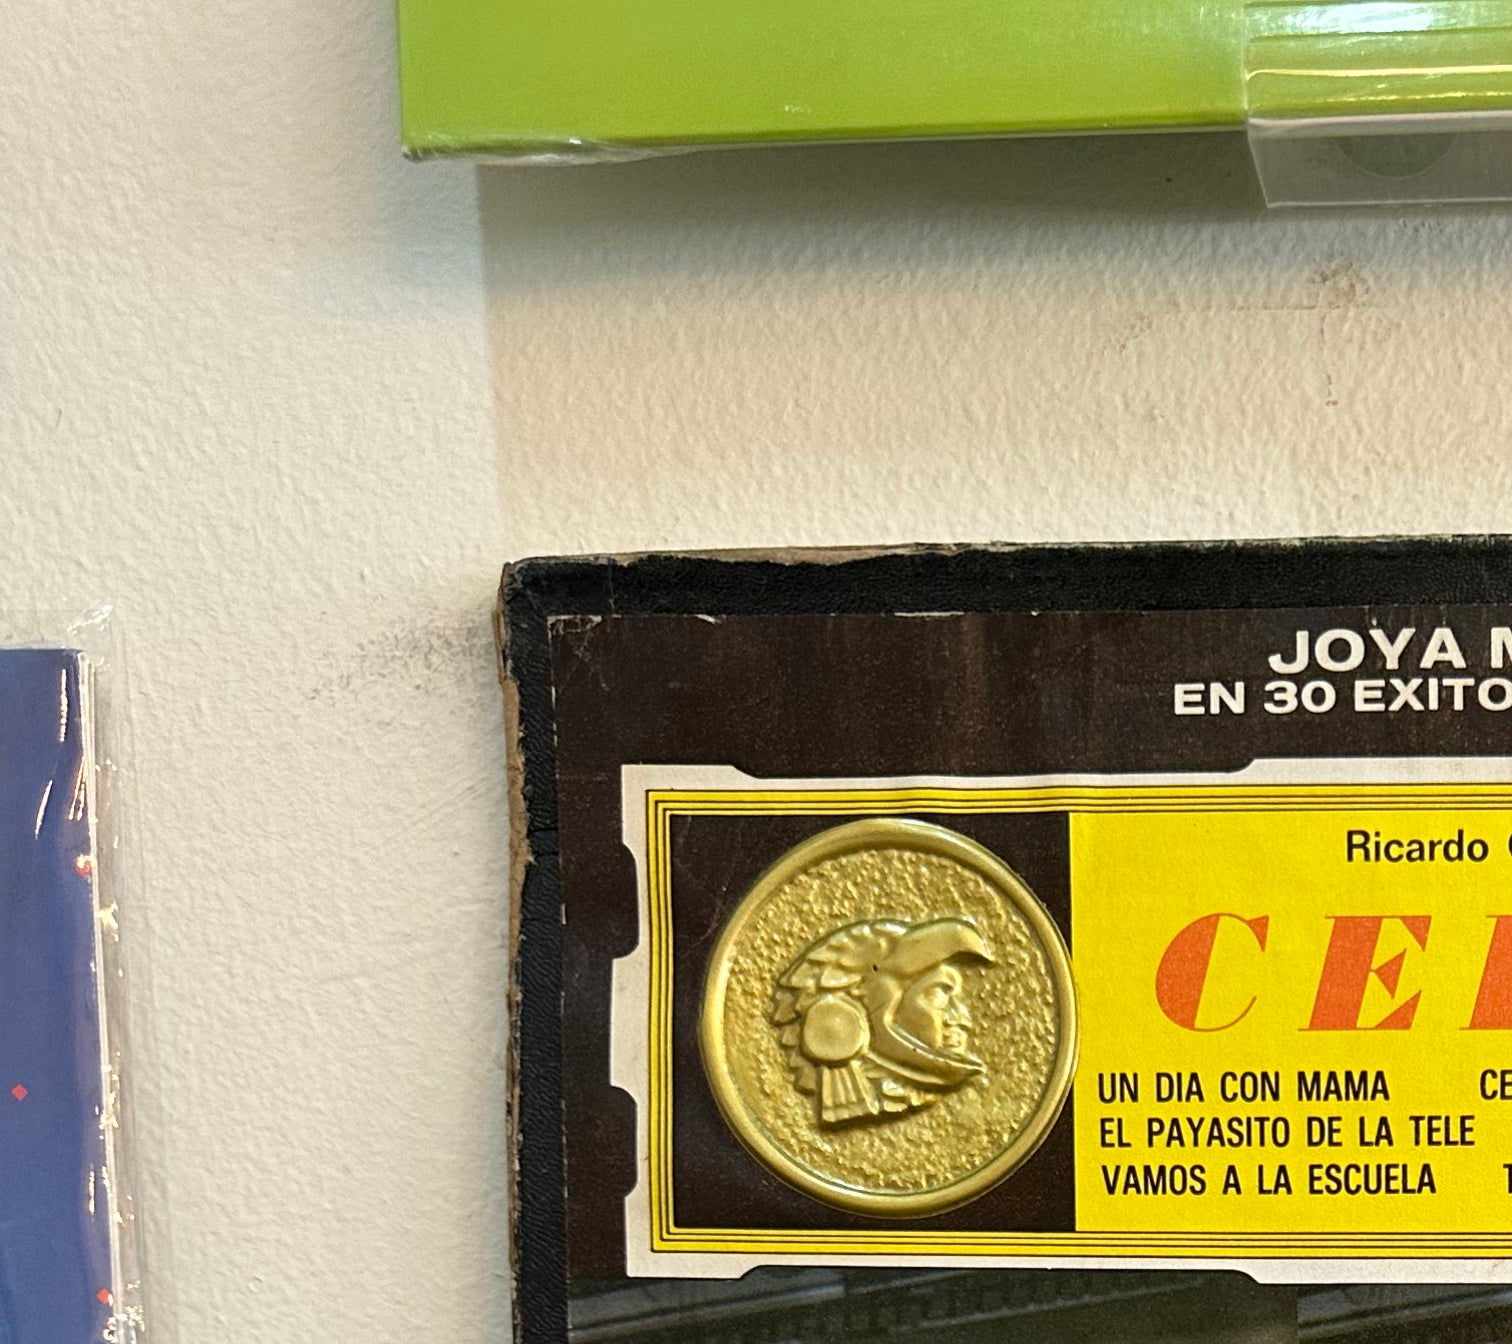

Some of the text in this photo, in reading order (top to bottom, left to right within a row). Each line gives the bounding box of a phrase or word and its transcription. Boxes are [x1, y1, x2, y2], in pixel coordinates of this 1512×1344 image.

[1268, 628, 1468, 674] JOYA
[1173, 682, 1245, 717] EN
[1263, 680, 1335, 713] 30
[1346, 829, 1490, 863] Ricardo
[1098, 1072, 1139, 1102] UN
[1155, 1072, 1205, 1102] DIA
[1220, 1071, 1281, 1102] CON
[1298, 1070, 1391, 1101] MAMA
[1099, 1117, 1132, 1148] EL
[1147, 1116, 1291, 1148] PAYASITO
[1306, 1115, 1343, 1147] DE
[1359, 1115, 1395, 1147] LA
[1408, 1114, 1476, 1147] TELE
[1101, 1164, 1206, 1196] VAMOS
[1222, 1164, 1243, 1195] A
[1257, 1164, 1293, 1195] LA
[1308, 1163, 1437, 1195] ESCUELA
